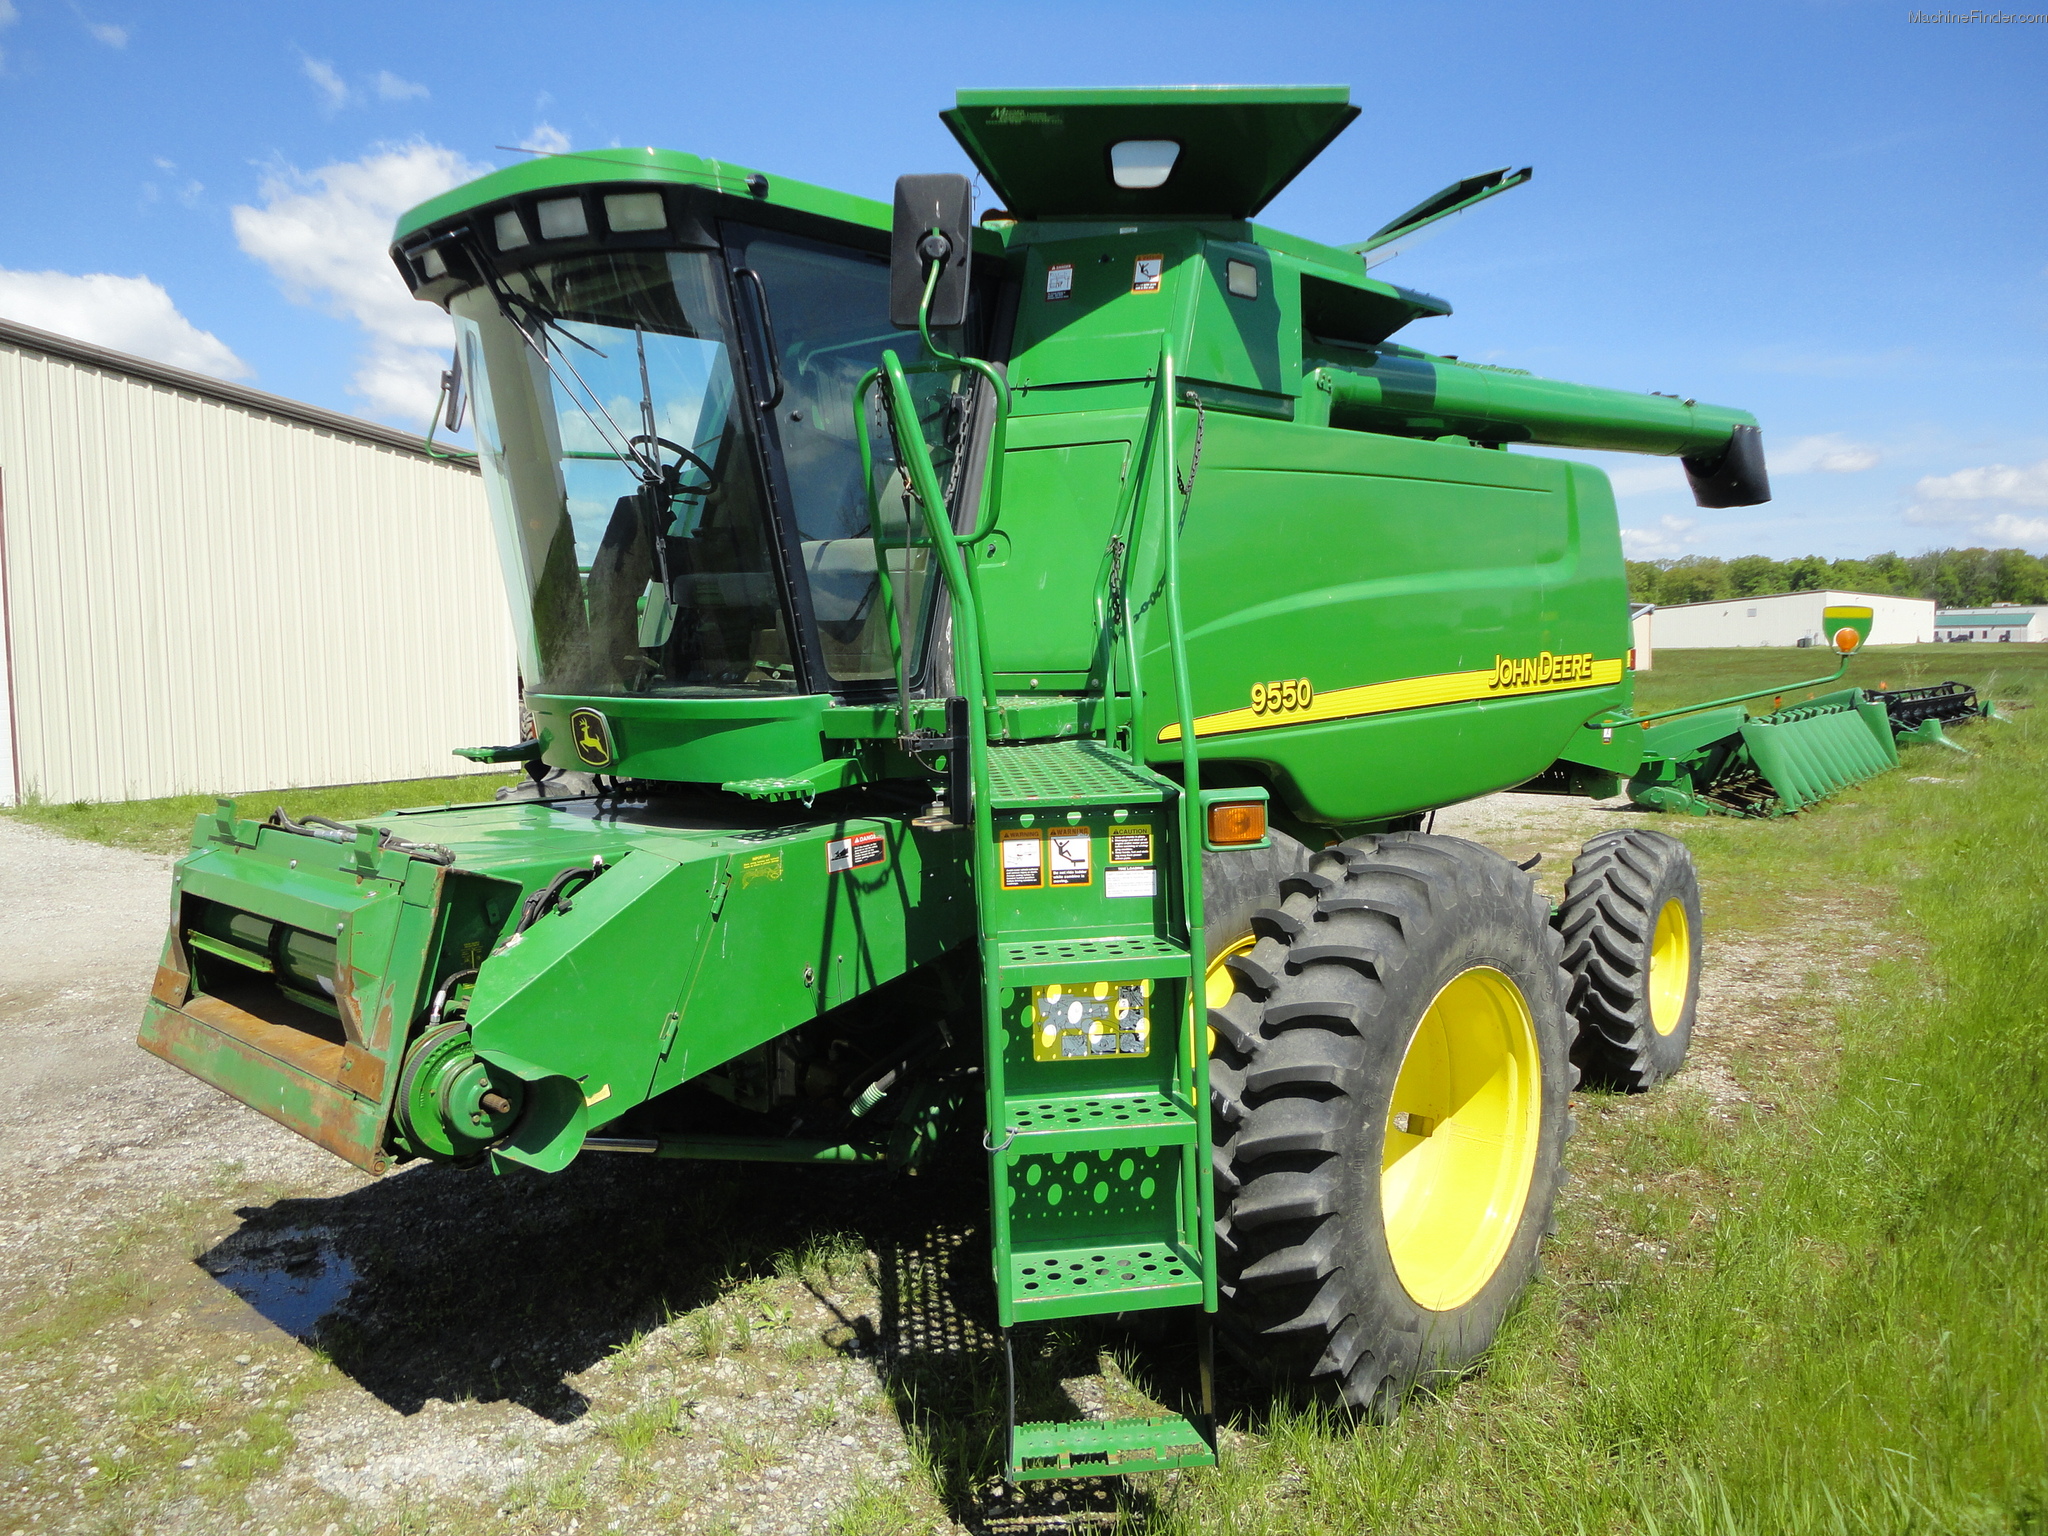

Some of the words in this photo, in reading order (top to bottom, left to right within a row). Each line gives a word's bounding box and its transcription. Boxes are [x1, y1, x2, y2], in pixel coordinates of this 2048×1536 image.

[1488, 654, 1538, 690] JOHN
[1539, 651, 1592, 684] DEERE
[1251, 677, 1313, 715] 9550
